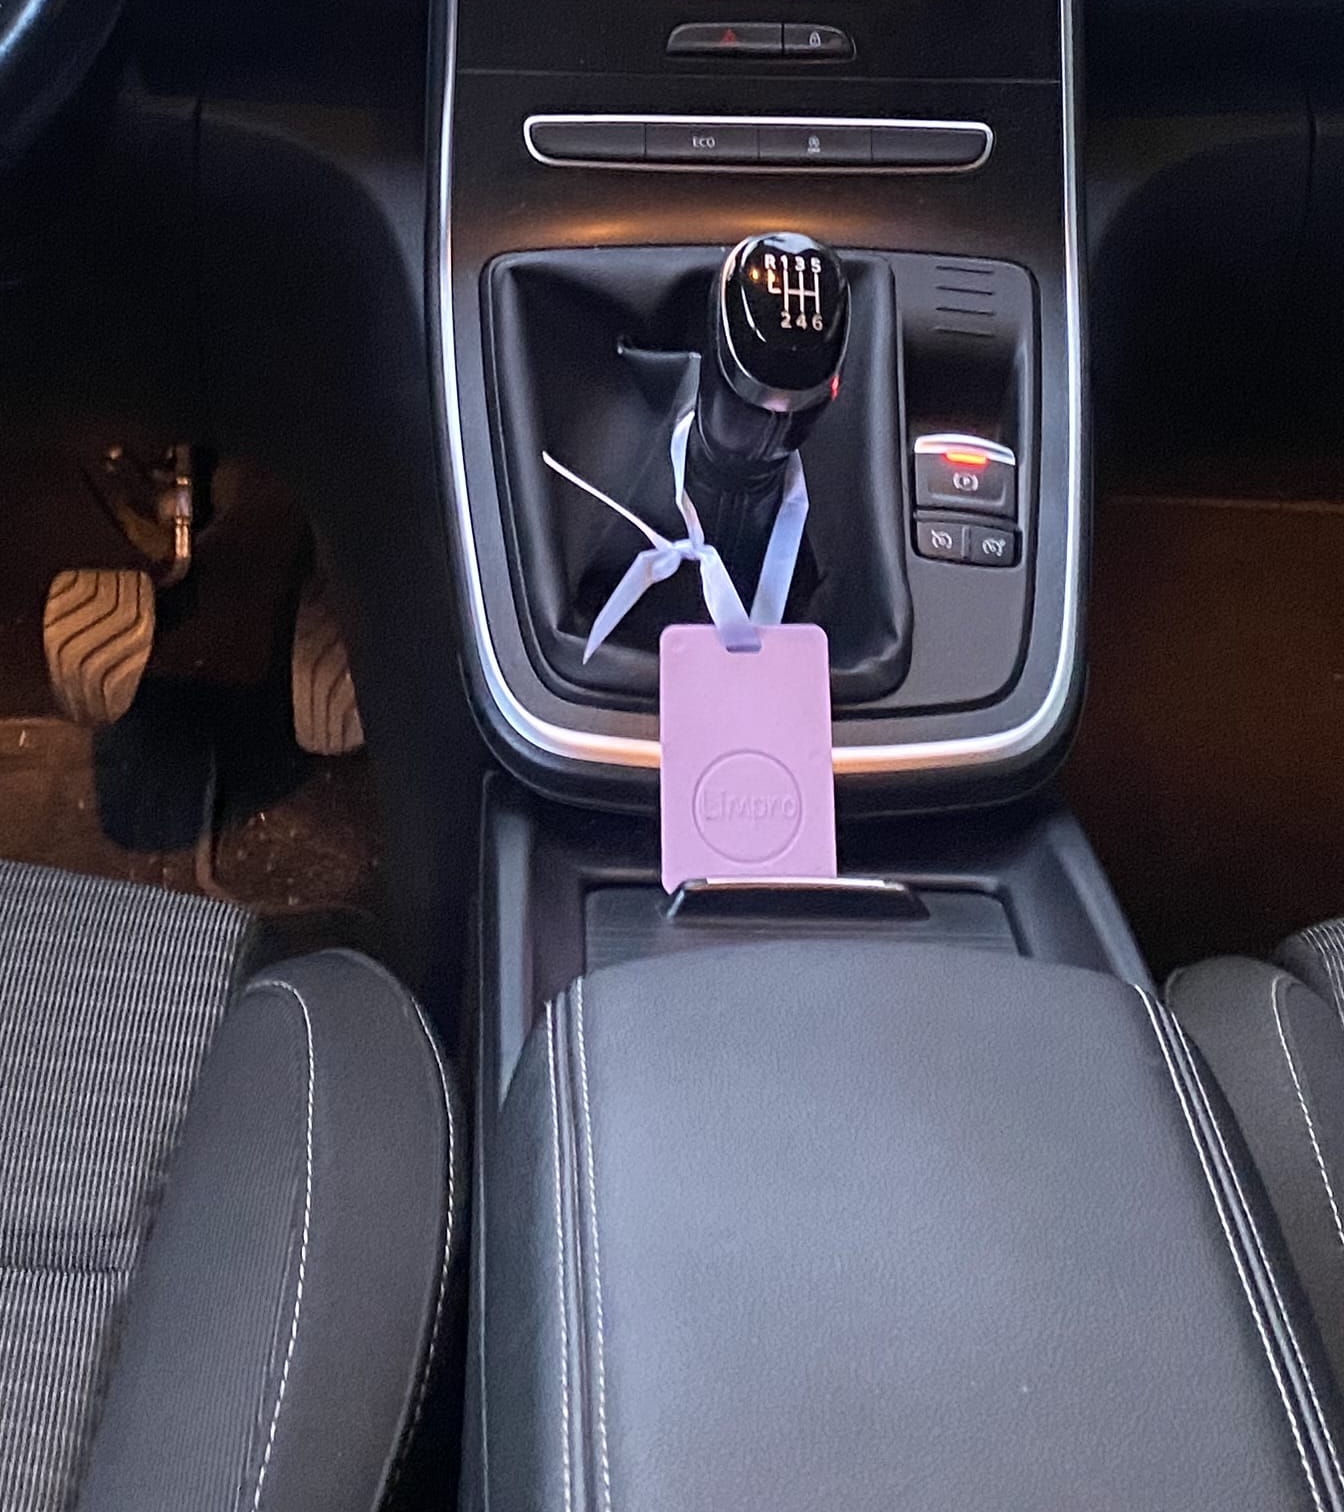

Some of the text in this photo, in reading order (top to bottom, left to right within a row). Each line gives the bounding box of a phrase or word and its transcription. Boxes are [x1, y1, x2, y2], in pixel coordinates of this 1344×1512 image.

[692, 136, 715, 148] ECO
[764, 253, 776, 270] R
[795, 255, 805, 272] 3
[810, 256, 822, 273] 5
[780, 310, 823, 331] 2 4 6
